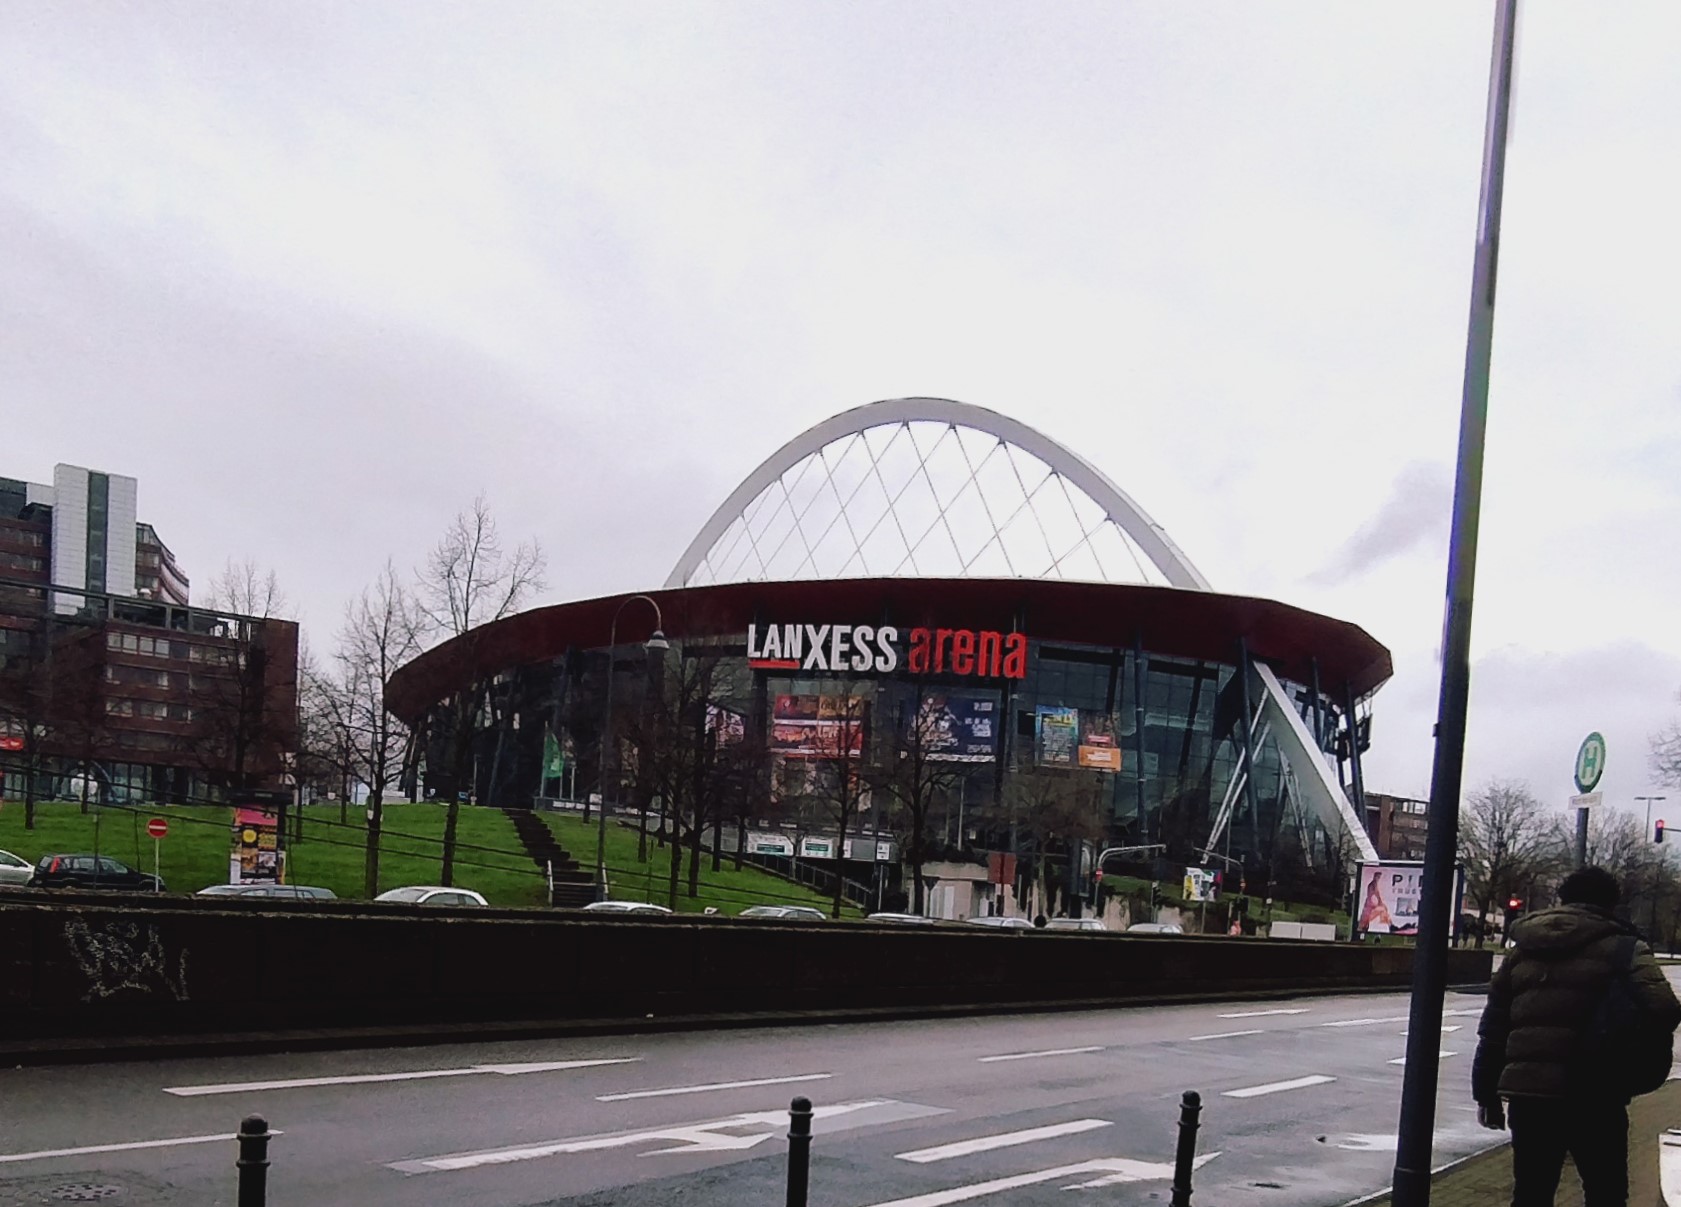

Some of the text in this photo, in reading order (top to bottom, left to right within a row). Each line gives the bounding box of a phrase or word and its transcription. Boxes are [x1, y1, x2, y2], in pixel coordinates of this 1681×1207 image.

[748, 624, 1028, 678] LANXESS arena
[1581, 746, 1597, 779] H
